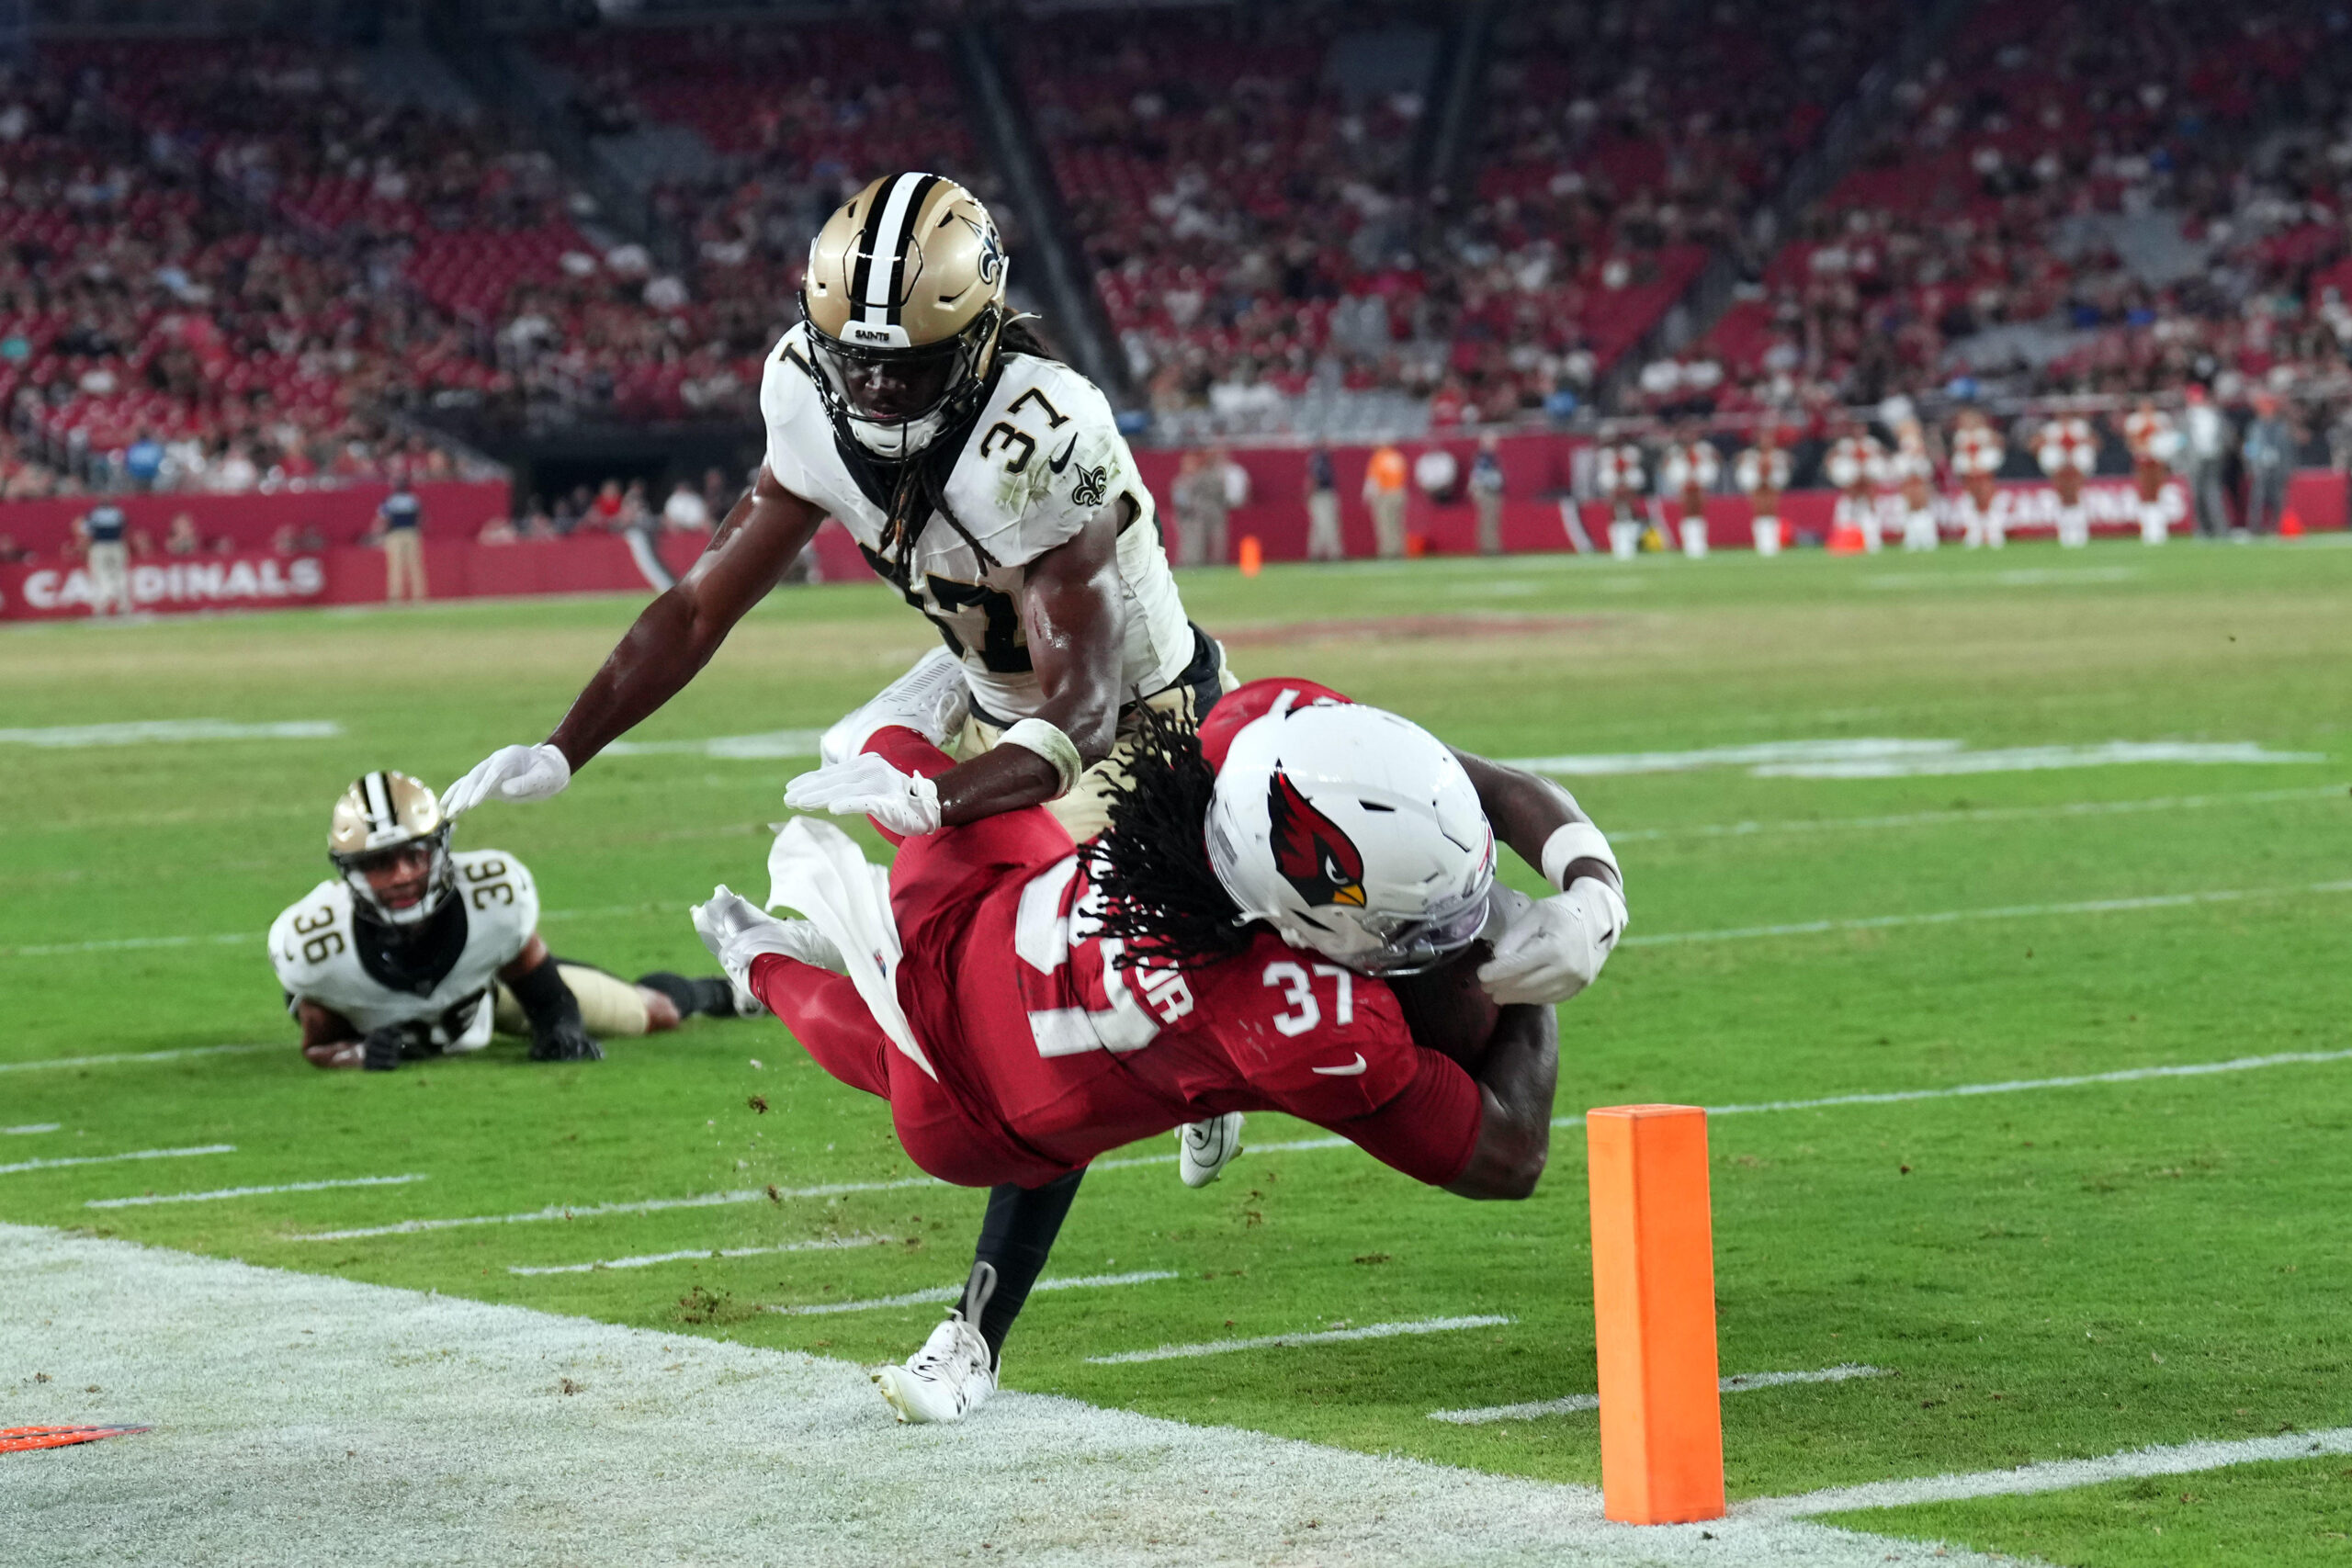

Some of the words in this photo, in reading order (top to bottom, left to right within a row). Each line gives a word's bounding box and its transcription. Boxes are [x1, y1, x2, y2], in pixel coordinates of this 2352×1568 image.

[854, 329, 889, 343] SAINTS
[979, 387, 1071, 475] 37
[23, 558, 323, 610] CADINALS
[464, 859, 514, 910] 36
[294, 905, 345, 965] 36
[1136, 956, 1194, 1025] JR
[1262, 961, 1354, 1038] 37
